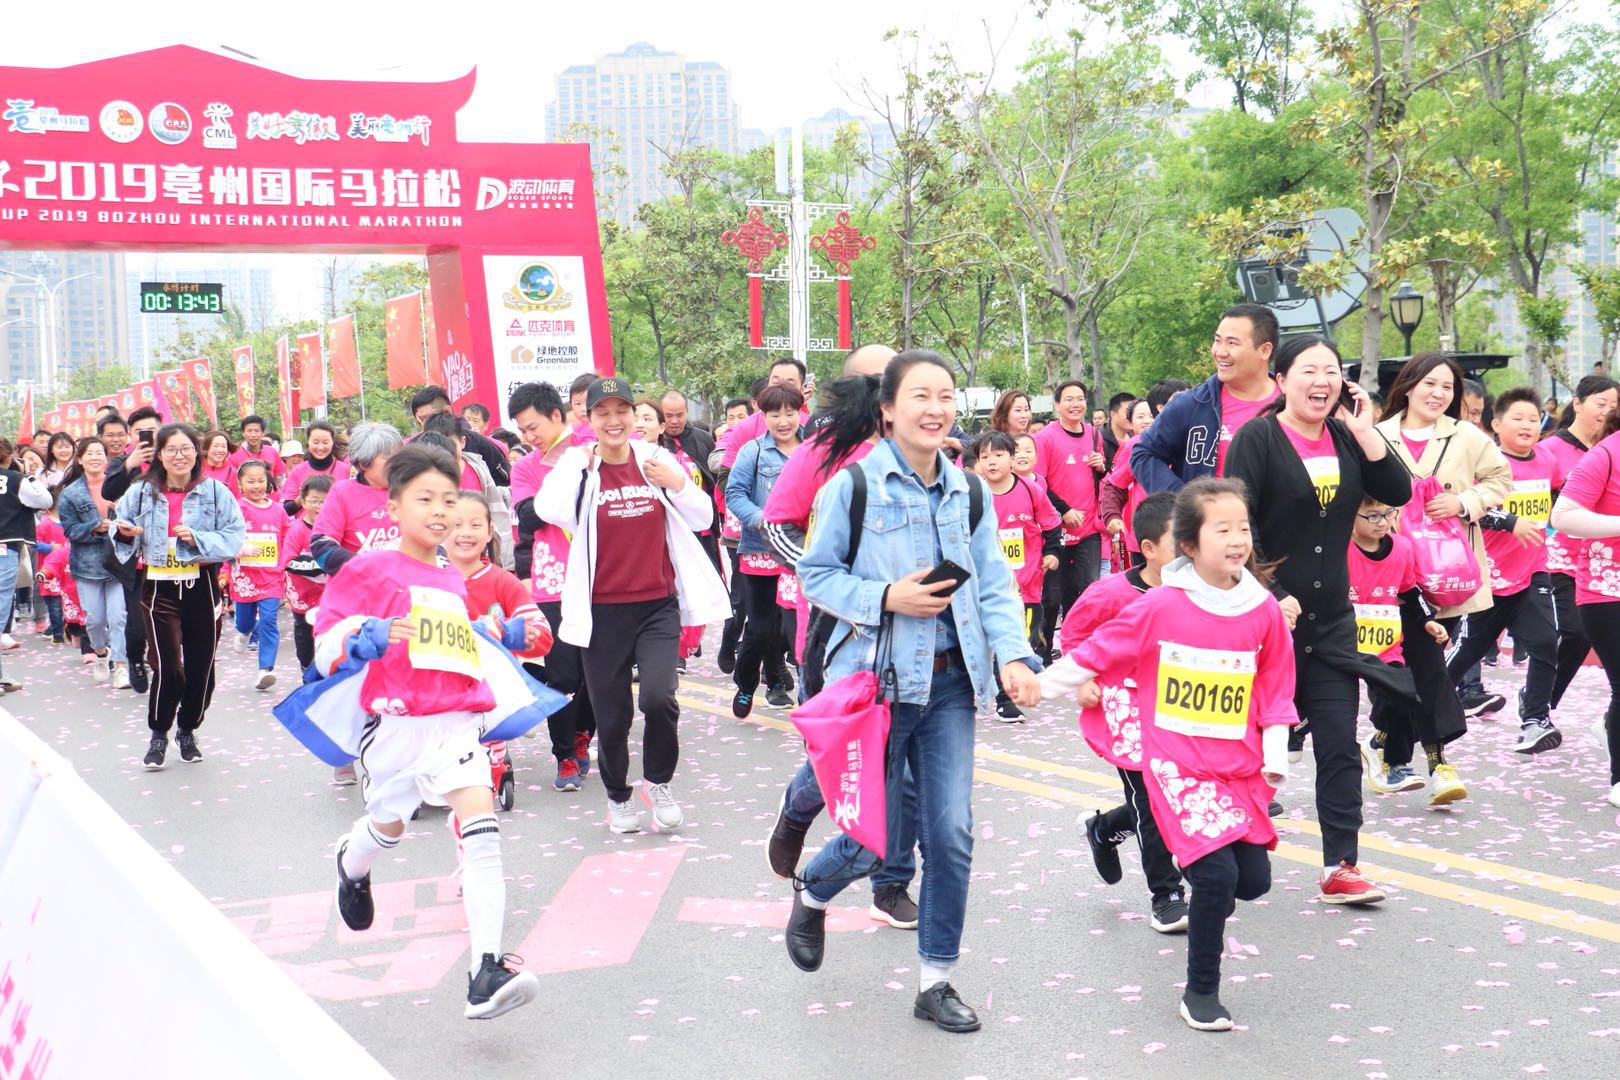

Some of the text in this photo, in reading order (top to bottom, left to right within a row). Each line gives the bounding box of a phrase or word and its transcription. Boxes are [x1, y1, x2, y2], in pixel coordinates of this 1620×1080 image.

[205, 128, 234, 139] CML
[508, 179, 575, 194] 波动体育
[38, 209, 88, 222] 2019
[97, 211, 181, 224] BOZHOU
[189, 213, 350, 227] INTERNATIONAL
[358, 215, 463, 227] MARATHON
[144, 293, 220, 311] 00:13:43
[528, 320, 575, 332] 匹克体育
[536, 345, 578, 356] 绿地控股
[536, 356, 579, 364] Greenland
[1509, 498, 1549, 516] D18540
[1165, 676, 1246, 714] D20166
